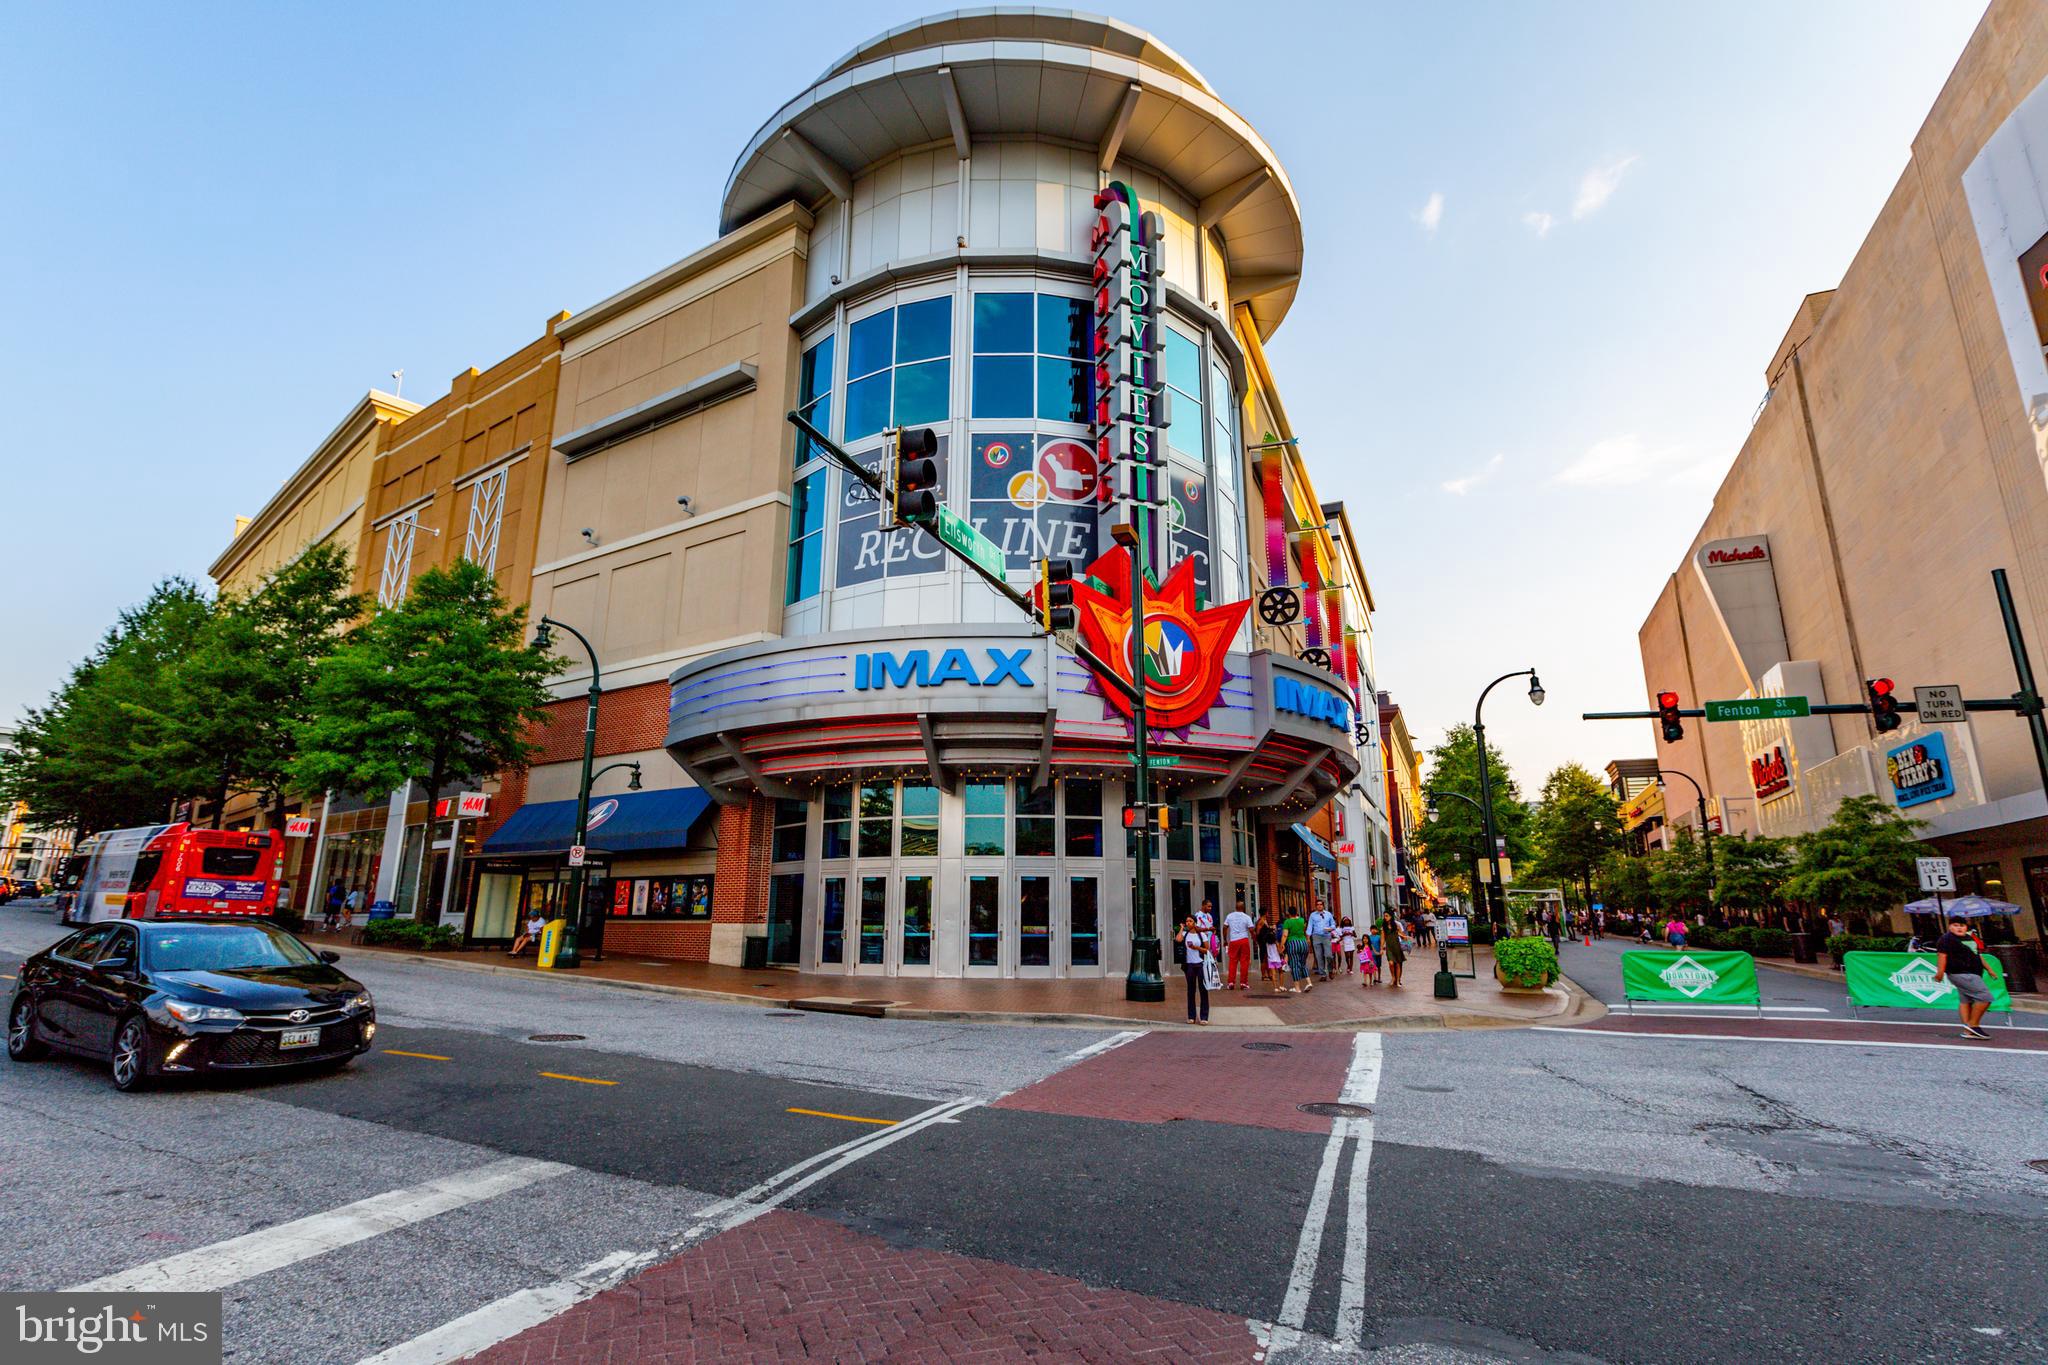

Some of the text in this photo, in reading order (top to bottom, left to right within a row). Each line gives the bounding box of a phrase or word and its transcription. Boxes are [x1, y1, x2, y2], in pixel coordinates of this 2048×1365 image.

[1127, 251, 1151, 455] MOVIES
[1708, 546, 1765, 563] Michaels
[855, 648, 1034, 691] IMAX
[1929, 690, 1947, 698] NO
[1274, 676, 1351, 733] IMAX
[1776, 699, 1787, 707] St
[1926, 700, 1954, 708] TURN
[1718, 705, 1760, 717] Fenton
[1150, 758, 1170, 766] FENTON
[1896, 747, 1917, 771] BEN
[1900, 759, 1938, 788] JERRY'S
[461, 797, 484, 811] H&M
[289, 822, 309, 832] H&M
[1339, 842, 1354, 853] H&M
[1928, 875, 1949, 887] 15
